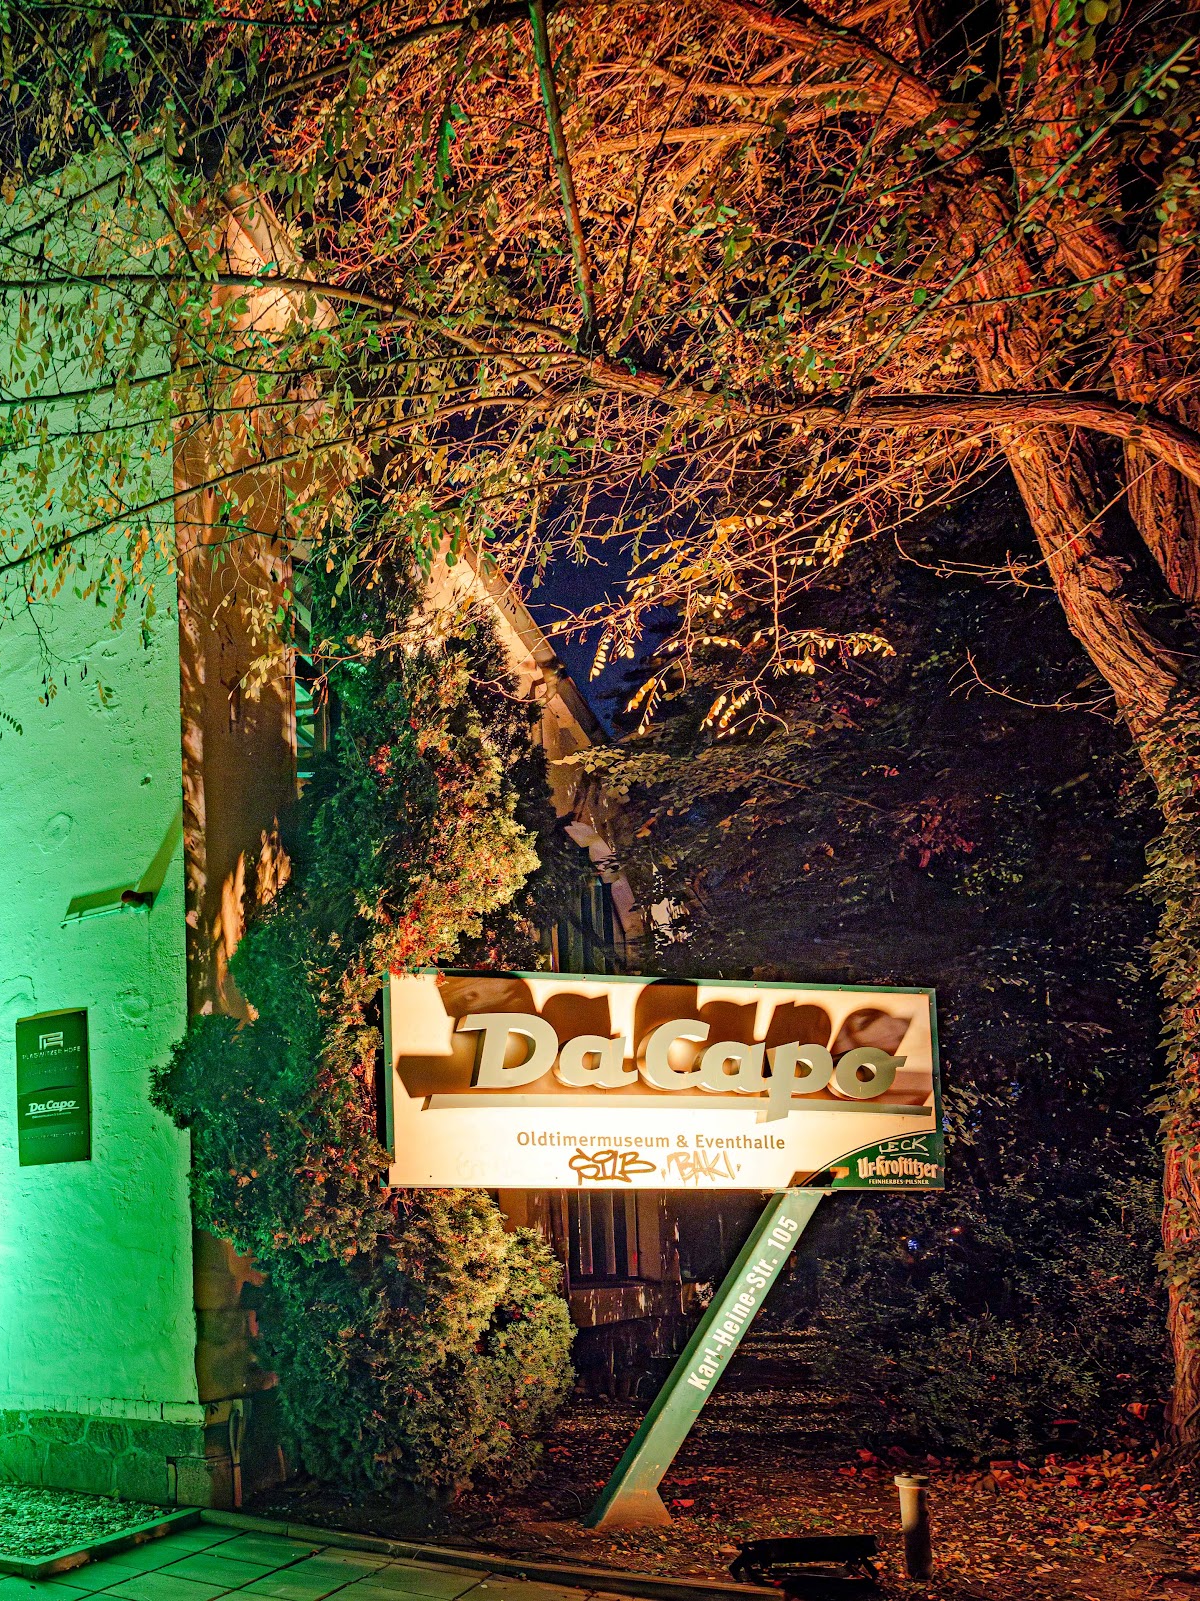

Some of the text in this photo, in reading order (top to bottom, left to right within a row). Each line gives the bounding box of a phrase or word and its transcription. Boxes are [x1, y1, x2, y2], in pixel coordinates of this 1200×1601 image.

[516, 1131, 786, 1150] Oldtimermuseum & Eventhalle
[868, 1178, 930, 1186] FEINHERBES PILSNER
[687, 1215, 799, 1392] Karl-Heine-Str. 105
